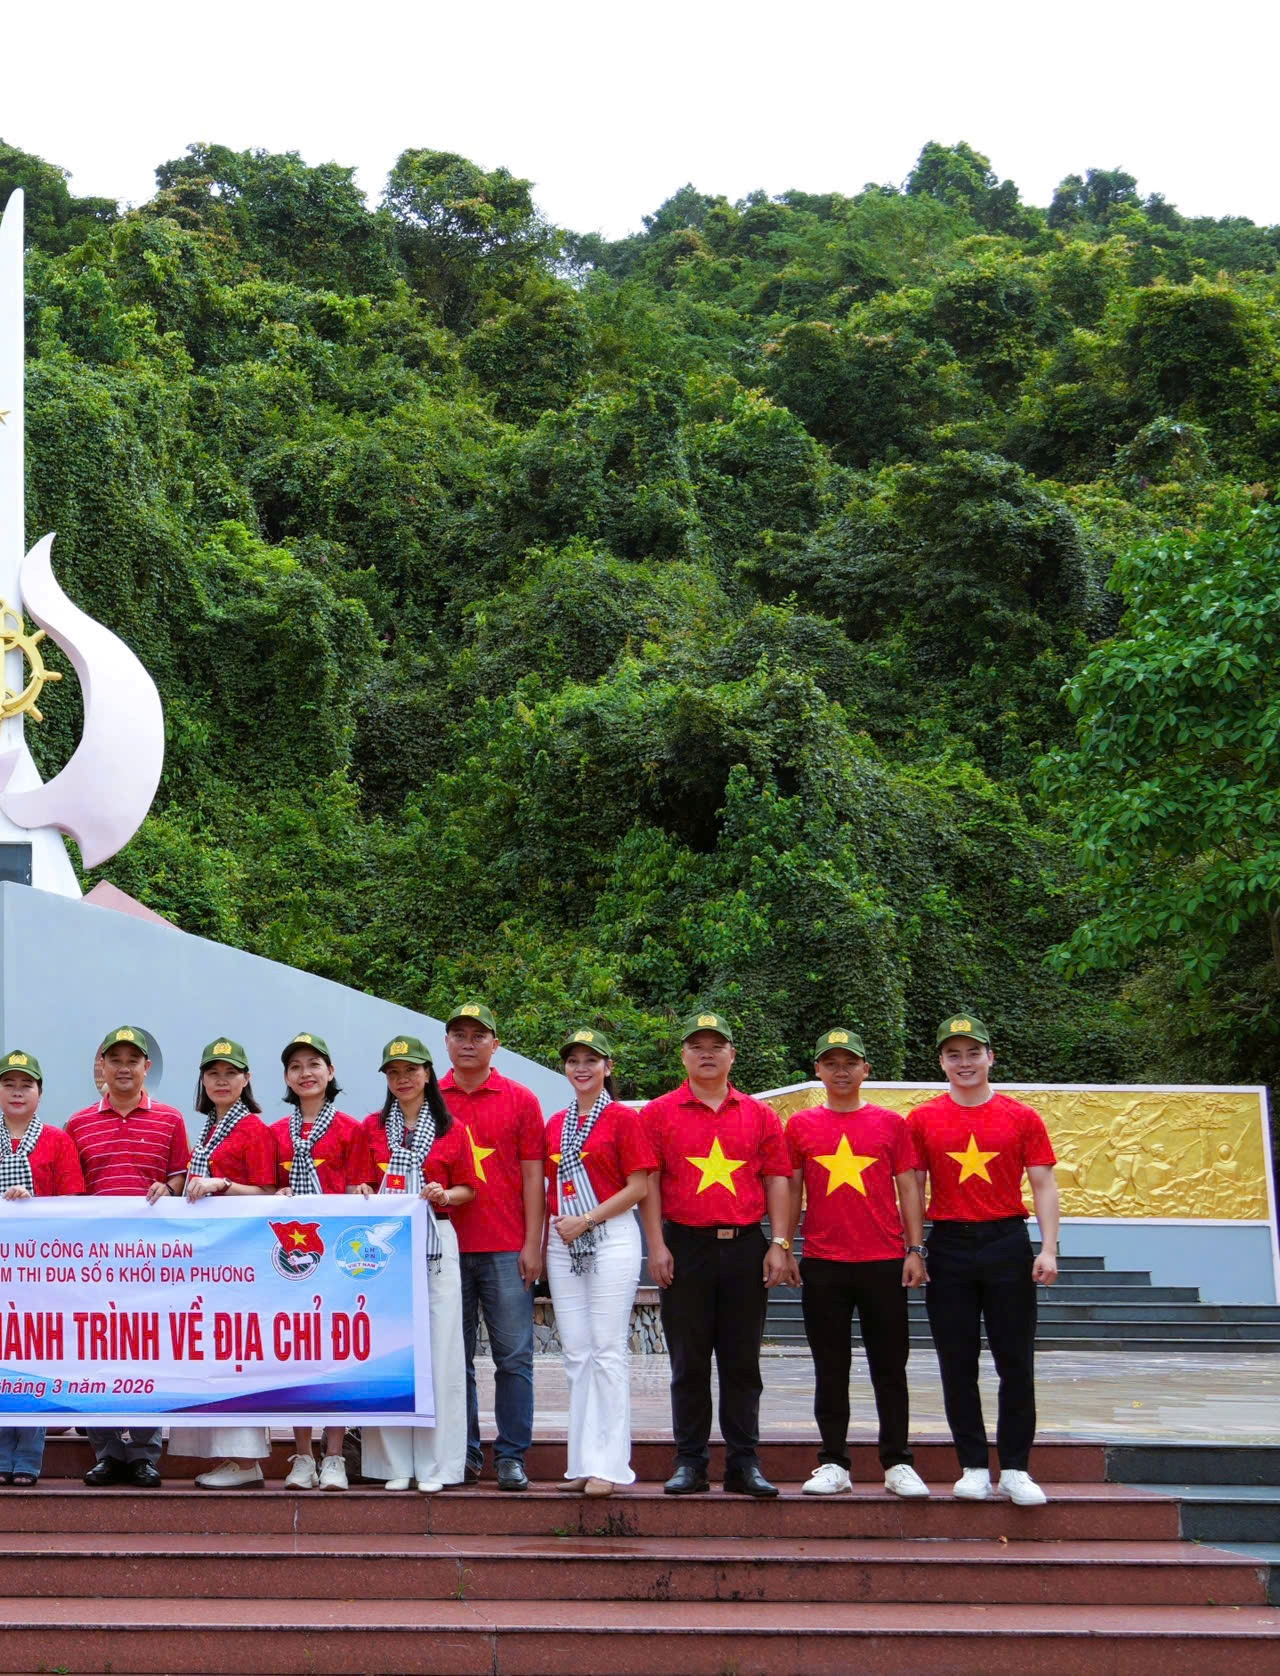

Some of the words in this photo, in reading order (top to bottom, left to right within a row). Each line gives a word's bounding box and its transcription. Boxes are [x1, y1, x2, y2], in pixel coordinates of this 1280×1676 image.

[15, 1239, 36, 1259] NỮ
[40, 1239, 84, 1259] CÔNG
[89, 1243, 109, 1258] AN
[114, 1239, 157, 1258] NHÂN
[162, 1239, 193, 1258] DÂN
[17, 1267, 41, 1283] THI
[46, 1267, 76, 1283] ĐUA
[81, 1261, 102, 1283] SỐ
[106, 1267, 114, 1283] 6
[119, 1261, 156, 1283] KHỐI
[160, 1267, 186, 1286] ĐỊA
[190, 1264, 255, 1283] PHƯƠNG
[73, 1301, 160, 1361] TRÌNH
[168, 1295, 204, 1361] VỀ
[213, 1311, 265, 1373] ĐỊA
[273, 1294, 322, 1362] CHỈ
[331, 1294, 371, 1362] ĐỎ
[52, 1379, 63, 1394] 3
[68, 1378, 107, 1394] năm
[112, 1379, 155, 1394] 2026
